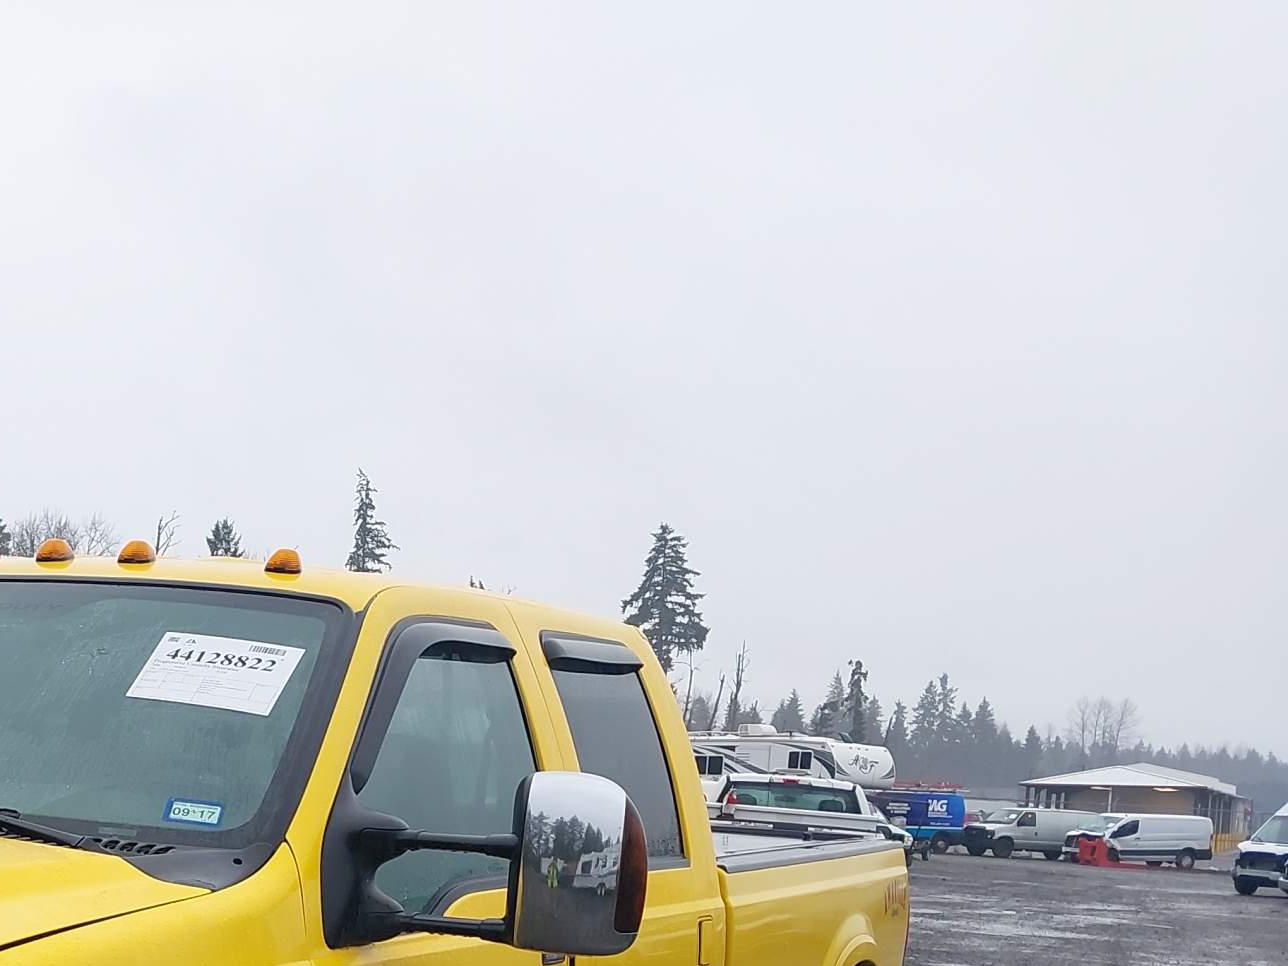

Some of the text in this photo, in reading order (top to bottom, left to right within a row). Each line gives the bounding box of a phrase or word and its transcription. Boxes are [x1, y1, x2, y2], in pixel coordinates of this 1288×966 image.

[166, 647, 277, 672] 44128822
[172, 806, 216, 820] 09 17
